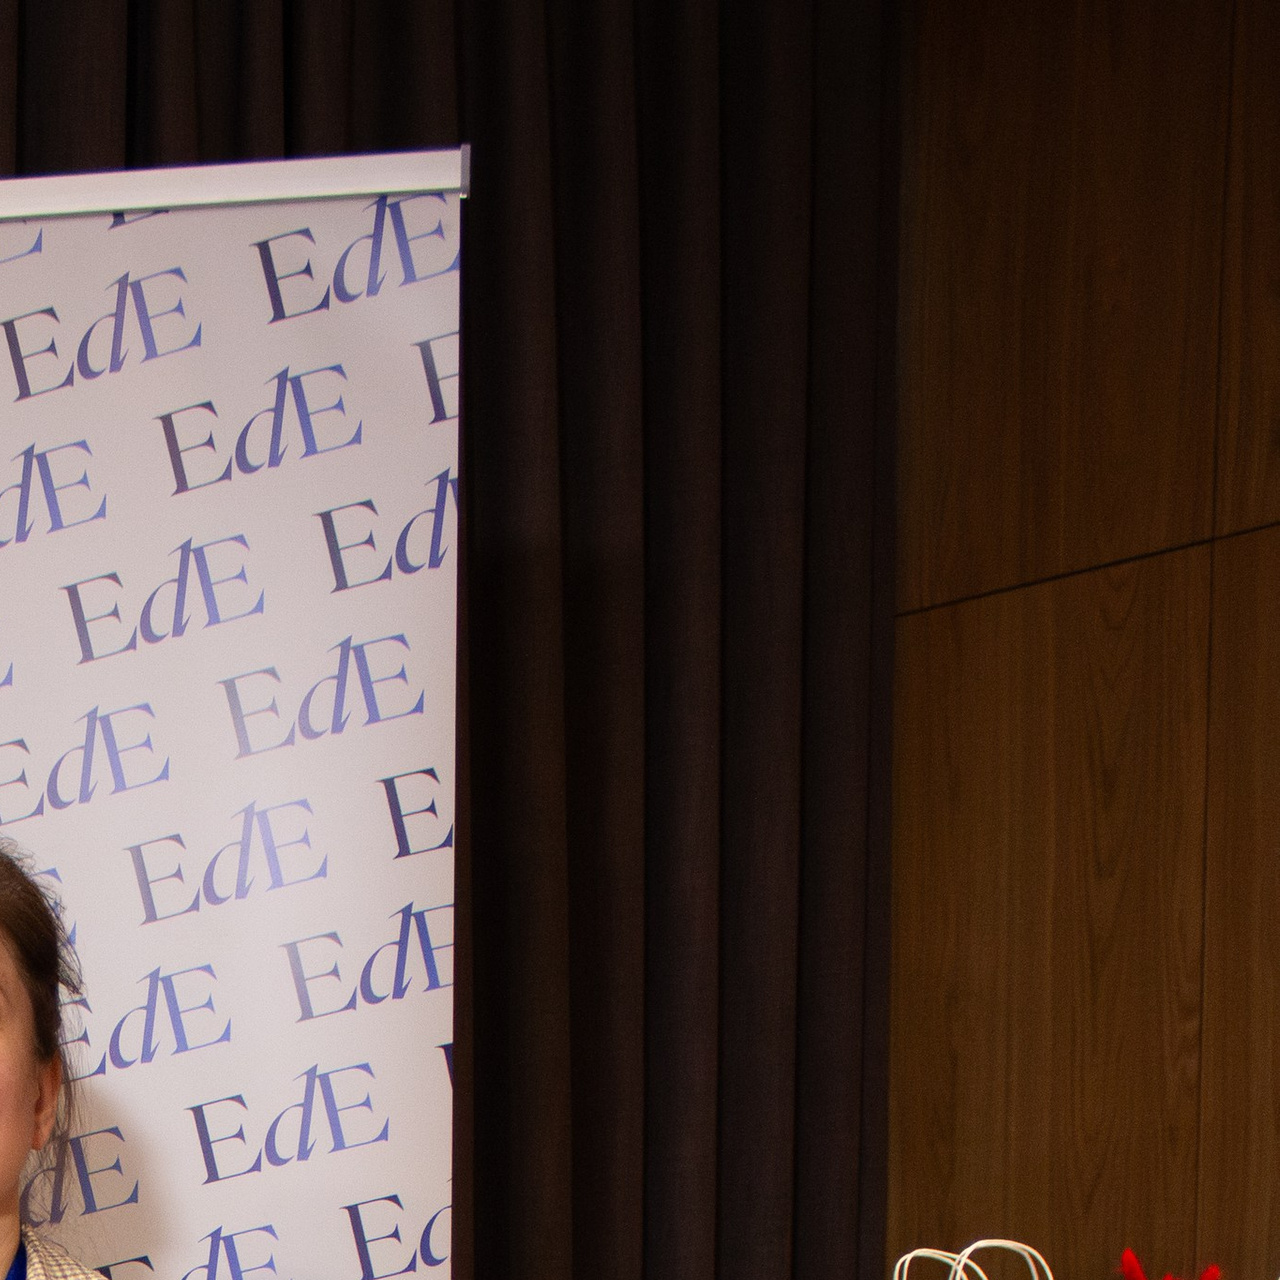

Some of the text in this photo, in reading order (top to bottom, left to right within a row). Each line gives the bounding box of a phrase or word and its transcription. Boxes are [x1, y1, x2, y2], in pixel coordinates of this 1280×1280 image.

[154, 362, 363, 496] EdE
[311, 466, 459, 594] Ed
[61, 533, 265, 664] EdE
[217, 632, 425, 760] EdE
[22, 1125, 139, 1229] dE
[186, 1062, 390, 1185] EdE
